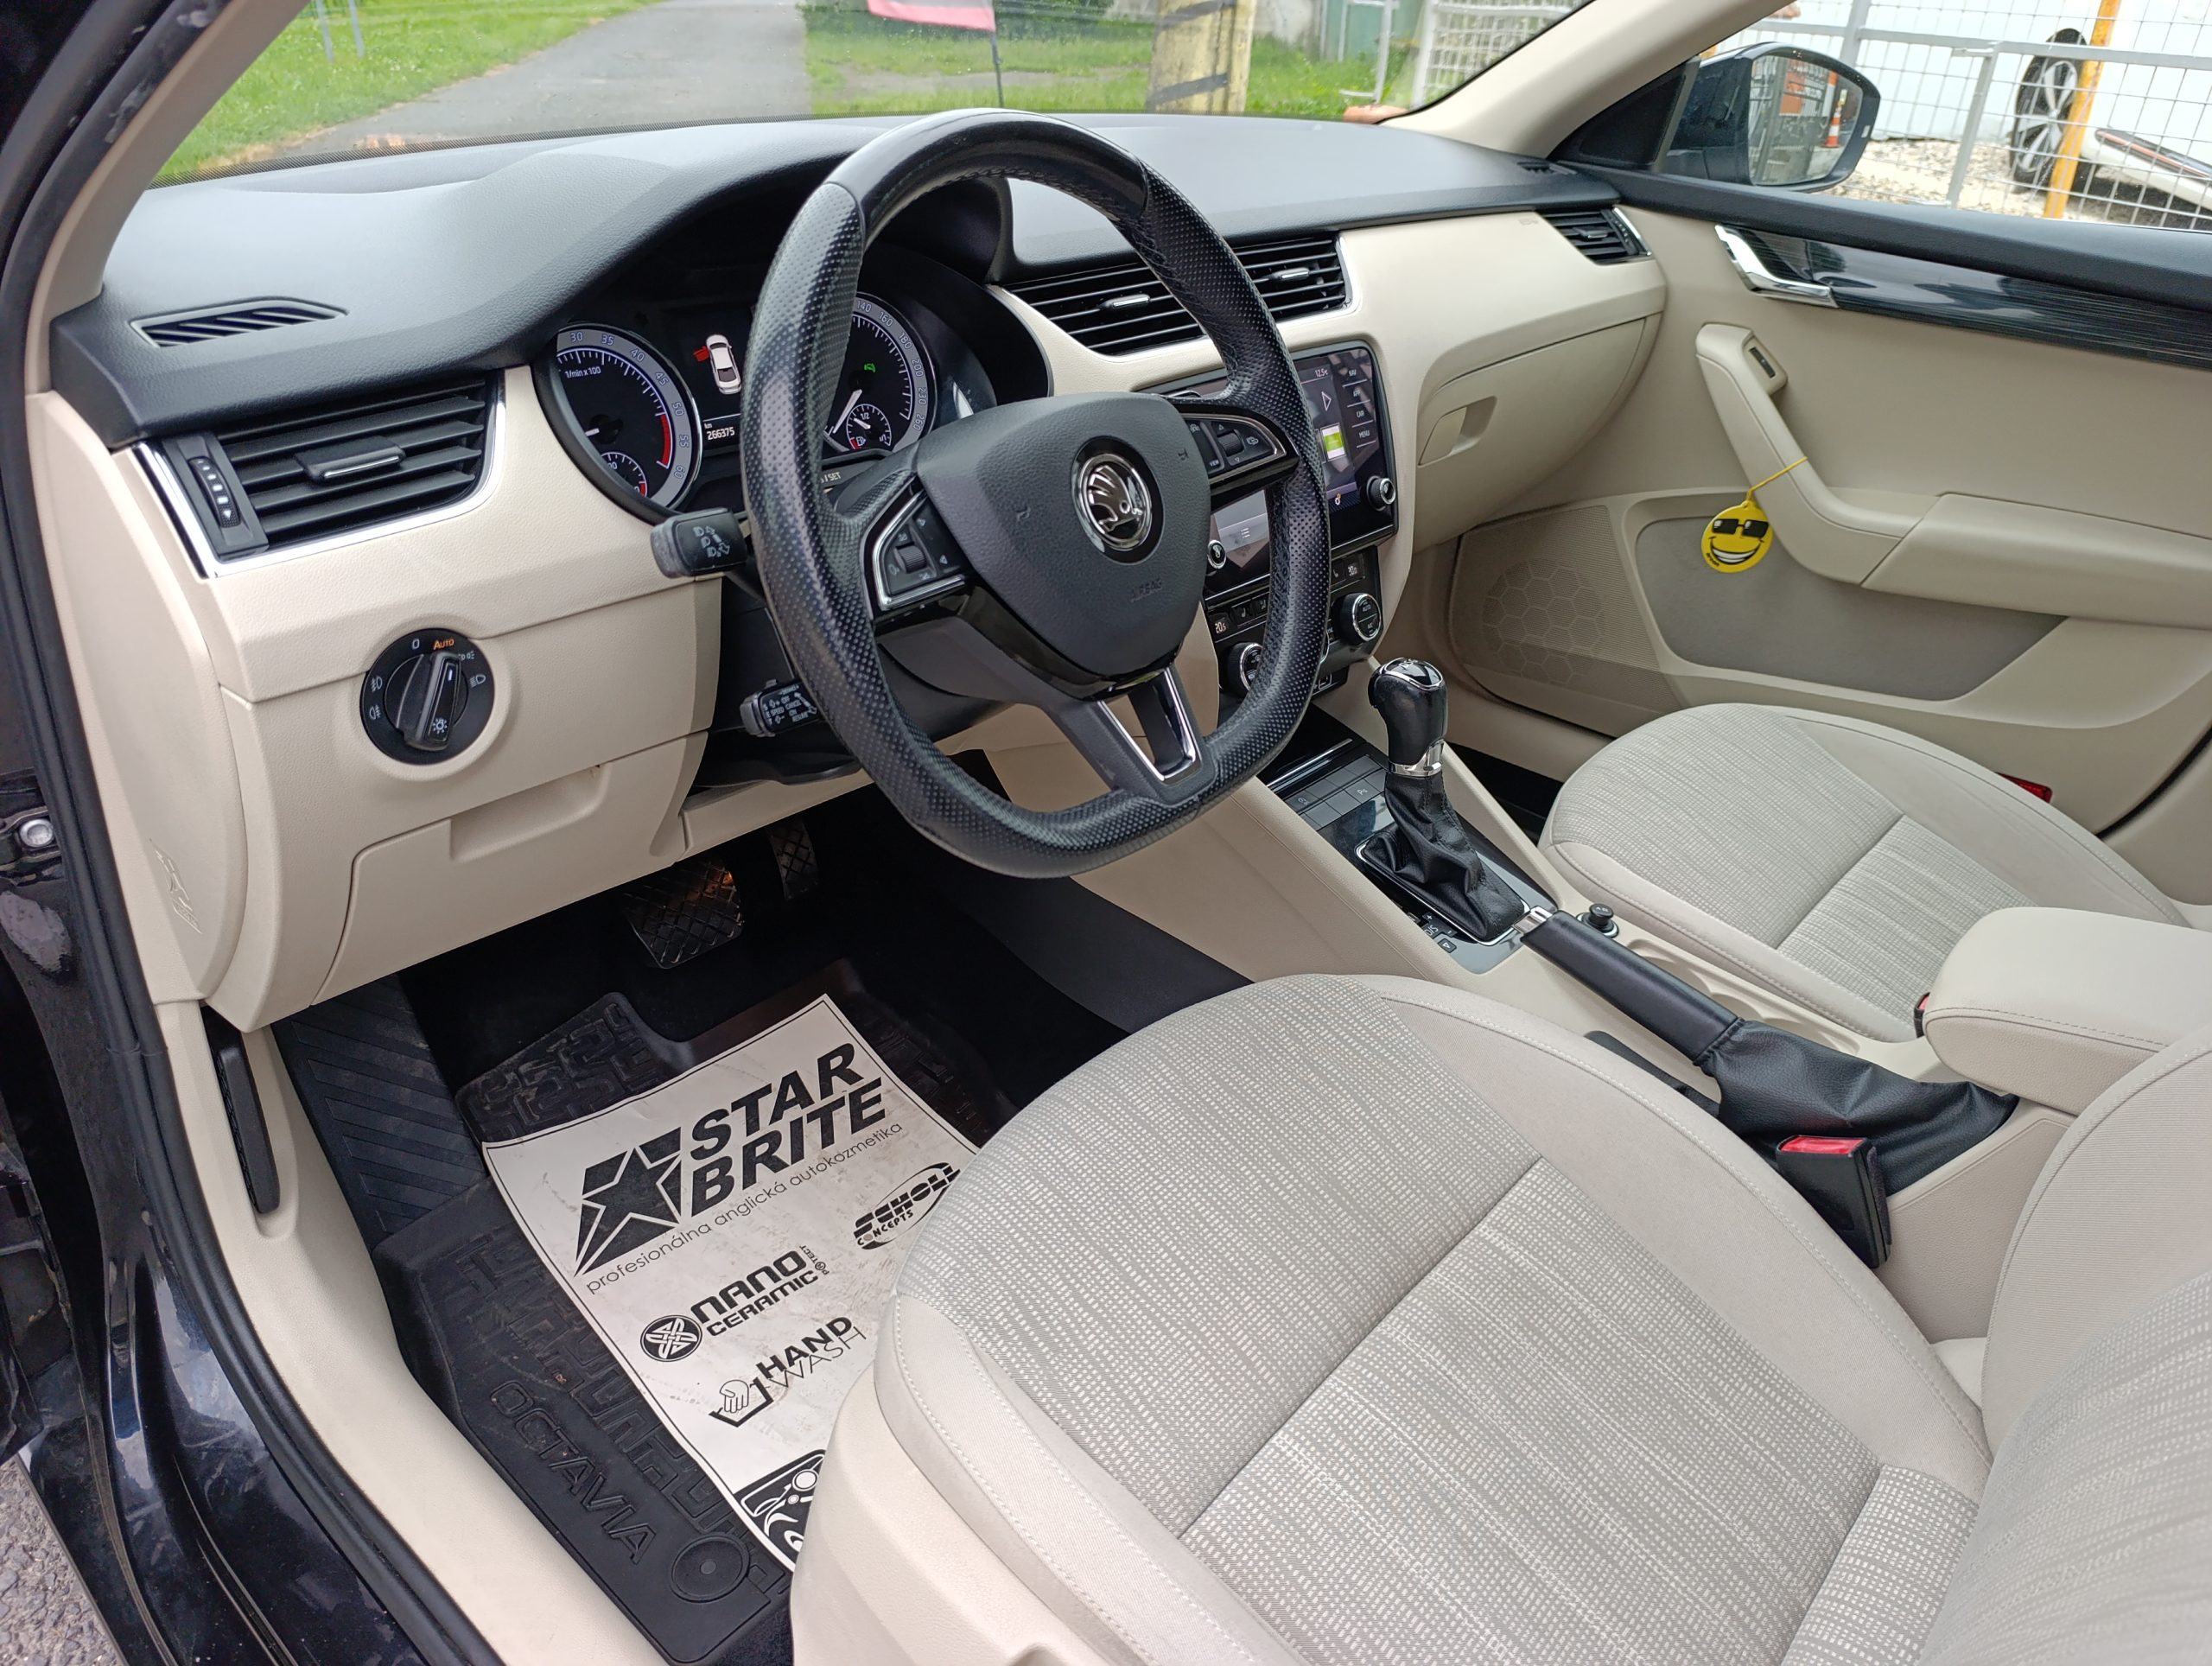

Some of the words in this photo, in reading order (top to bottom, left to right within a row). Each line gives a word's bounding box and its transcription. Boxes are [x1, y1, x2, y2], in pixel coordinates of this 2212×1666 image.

[856, 301, 871, 313] 140
[880, 312, 893, 327] 160
[570, 332, 583, 342] 30
[601, 334, 614, 346] 35
[898, 332, 912, 349] 180
[631, 348, 645, 361] 40
[564, 369, 583, 378] 1/min
[589, 366, 601, 375] 100
[912, 359, 924, 377] 200
[655, 372, 668, 385] 45
[918, 387, 927, 405] 230
[672, 402, 684, 416] 50
[913, 414, 925, 431] 260
[679, 434, 690, 448] 55
[707, 427, 734, 440] 266375
[674, 465, 685, 479] 60
[690, 1043, 864, 1160] STAR
[691, 1077, 886, 1217] BRITE
[586, 1223, 711, 1294] profesionálna
[715, 1181, 787, 1225] anglická
[790, 1123, 903, 1186] autokozmetika
[690, 1250, 807, 1324] NANO
[706, 1270, 818, 1336] CERAMIC
[756, 1317, 852, 1379] HAND
[769, 1326, 867, 1388] WASH
[490, 1381, 657, 1565] OCTAVIA
